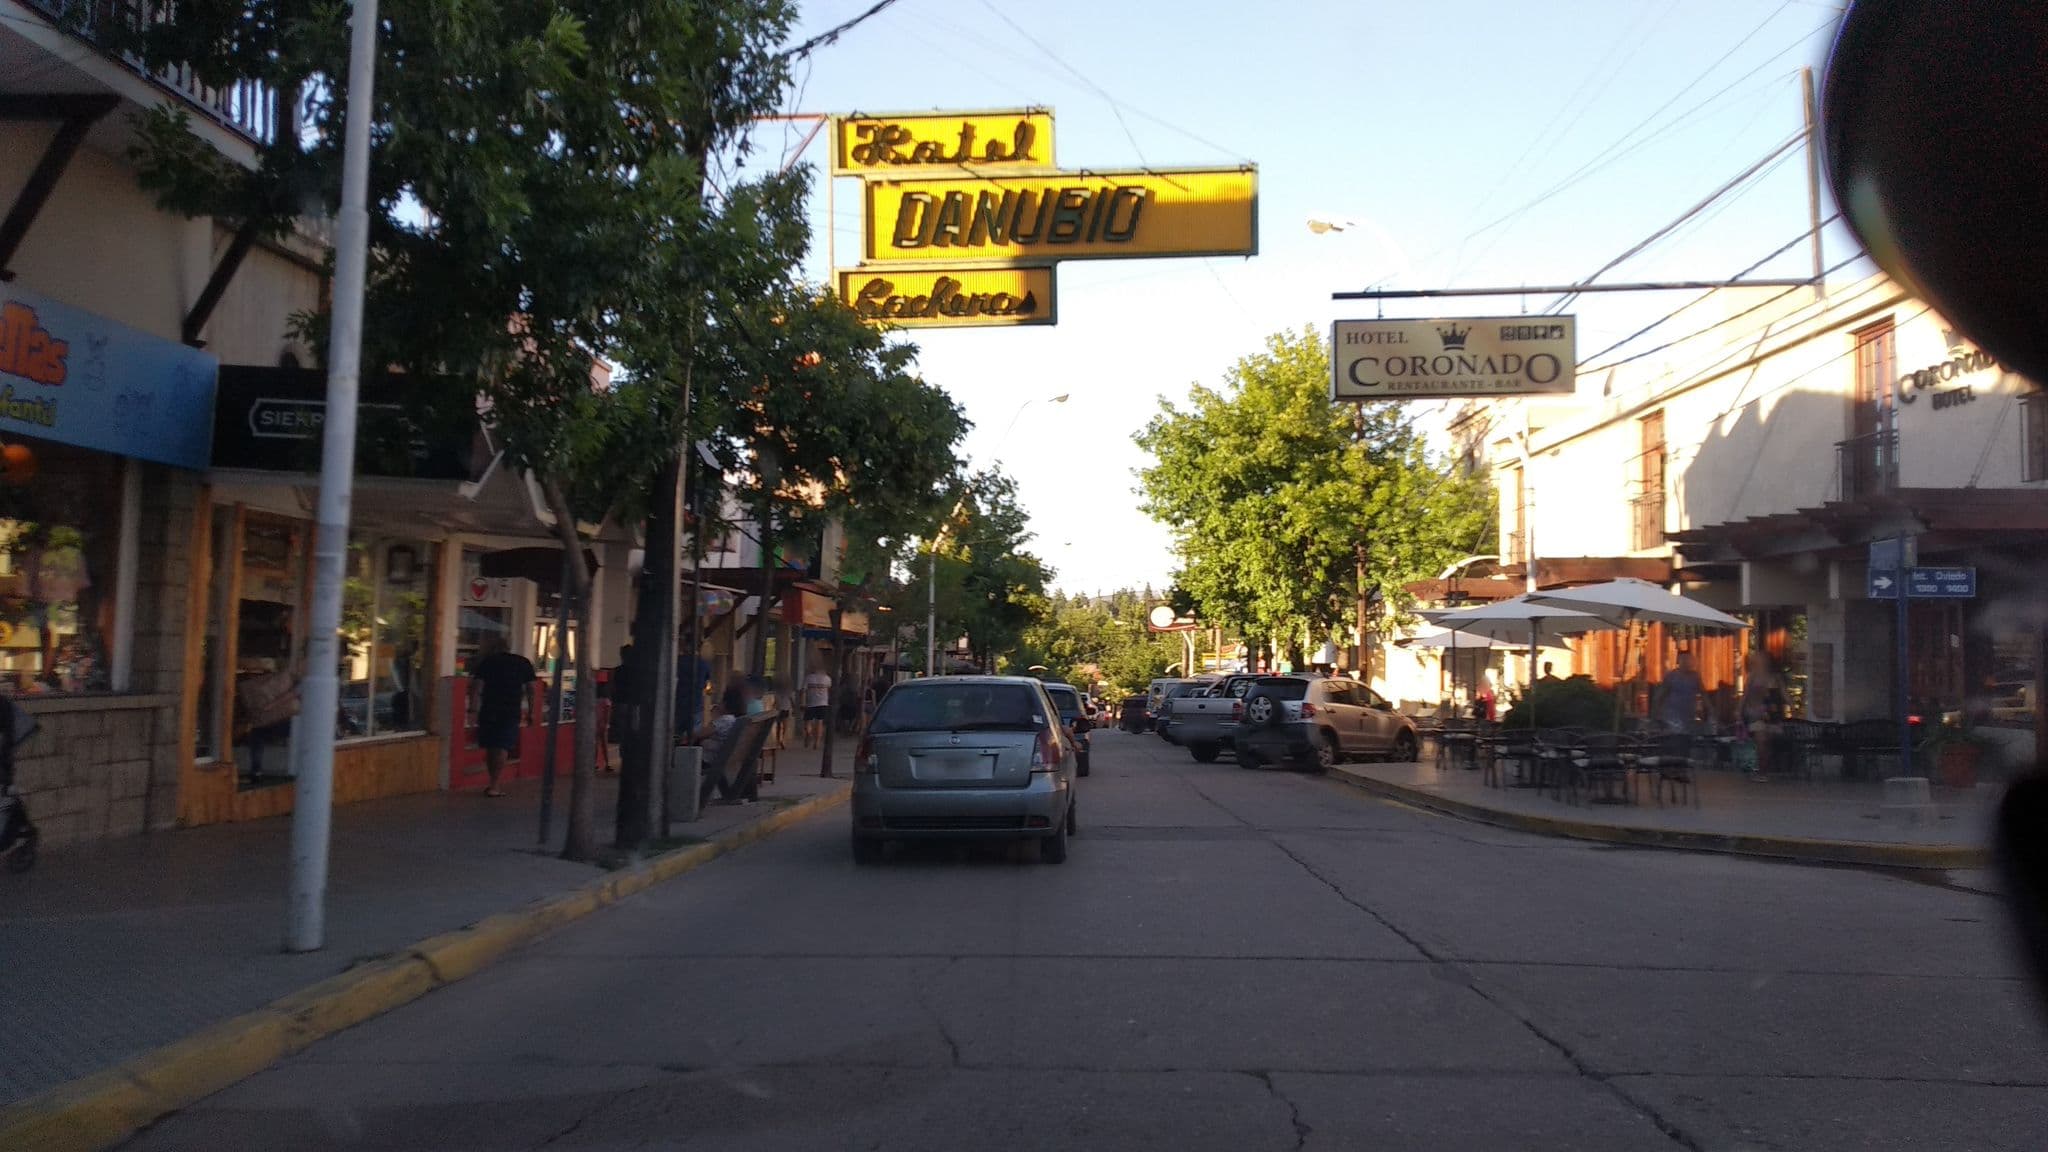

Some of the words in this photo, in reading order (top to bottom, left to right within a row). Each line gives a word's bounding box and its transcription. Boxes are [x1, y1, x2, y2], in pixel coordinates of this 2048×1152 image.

[852, 120, 1036, 165] Hotel
[893, 186, 1147, 248] DANUBIO
[1346, 330, 1408, 345] HOTEL
[1348, 352, 1562, 387] CORONADO
[1932, 385, 1976, 410] HOTEL
